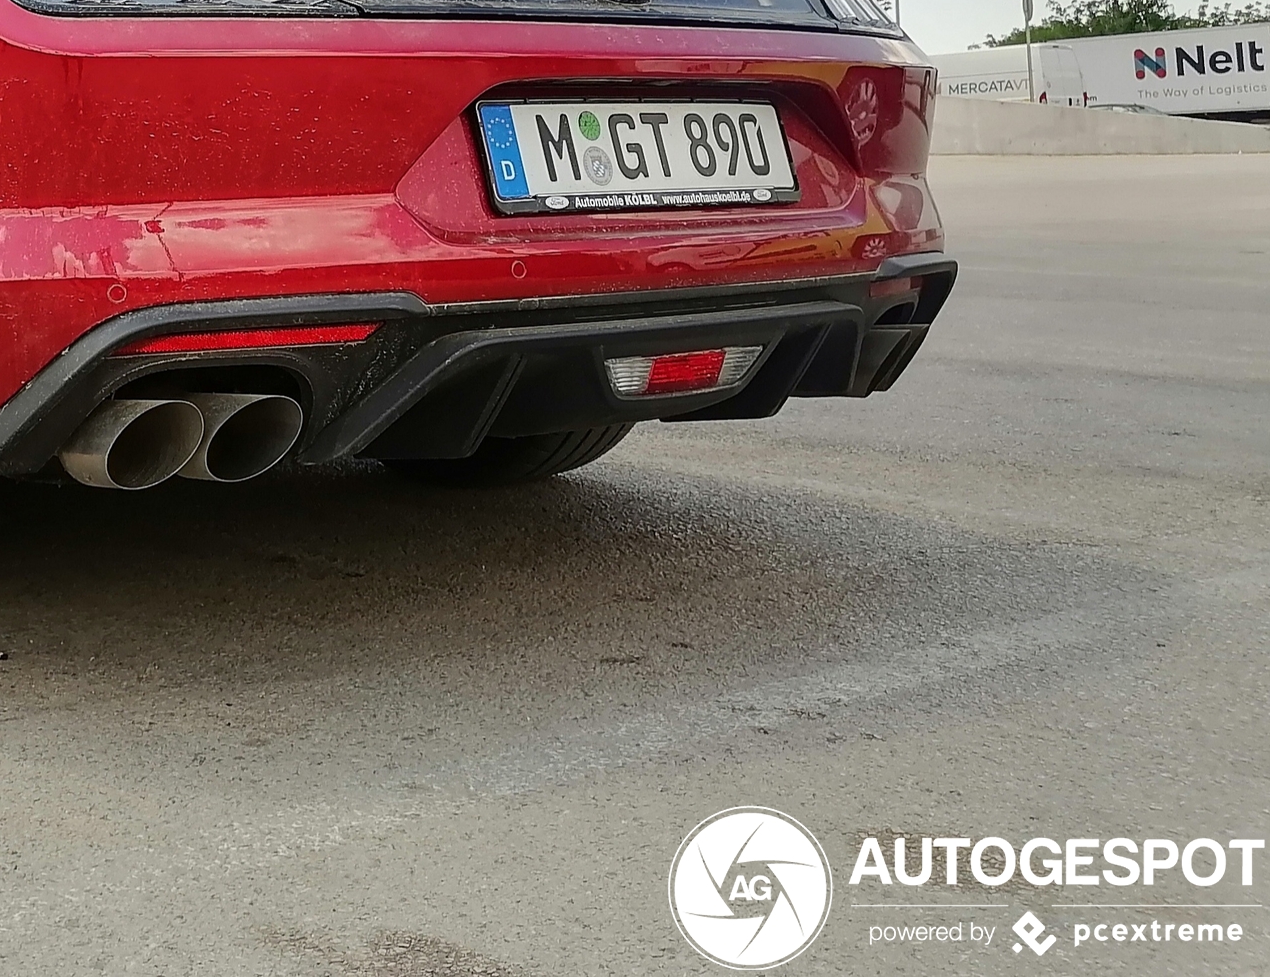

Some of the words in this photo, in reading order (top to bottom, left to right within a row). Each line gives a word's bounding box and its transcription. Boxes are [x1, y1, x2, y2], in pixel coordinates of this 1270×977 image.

[1175, 41, 1265, 76] Nelt
[1137, 89, 1159, 99] The
[1163, 87, 1189, 98] Way
[1192, 86, 1204, 96] of
[1209, 83, 1268, 95] Logistics
[535, 114, 582, 182] M
[608, 112, 670, 179] GT
[683, 112, 771, 178] 890
[501, 160, 516, 181] D
[575, 195, 624, 209] Automobile
[661, 191, 751, 204] www.autohauskoelbl.de
